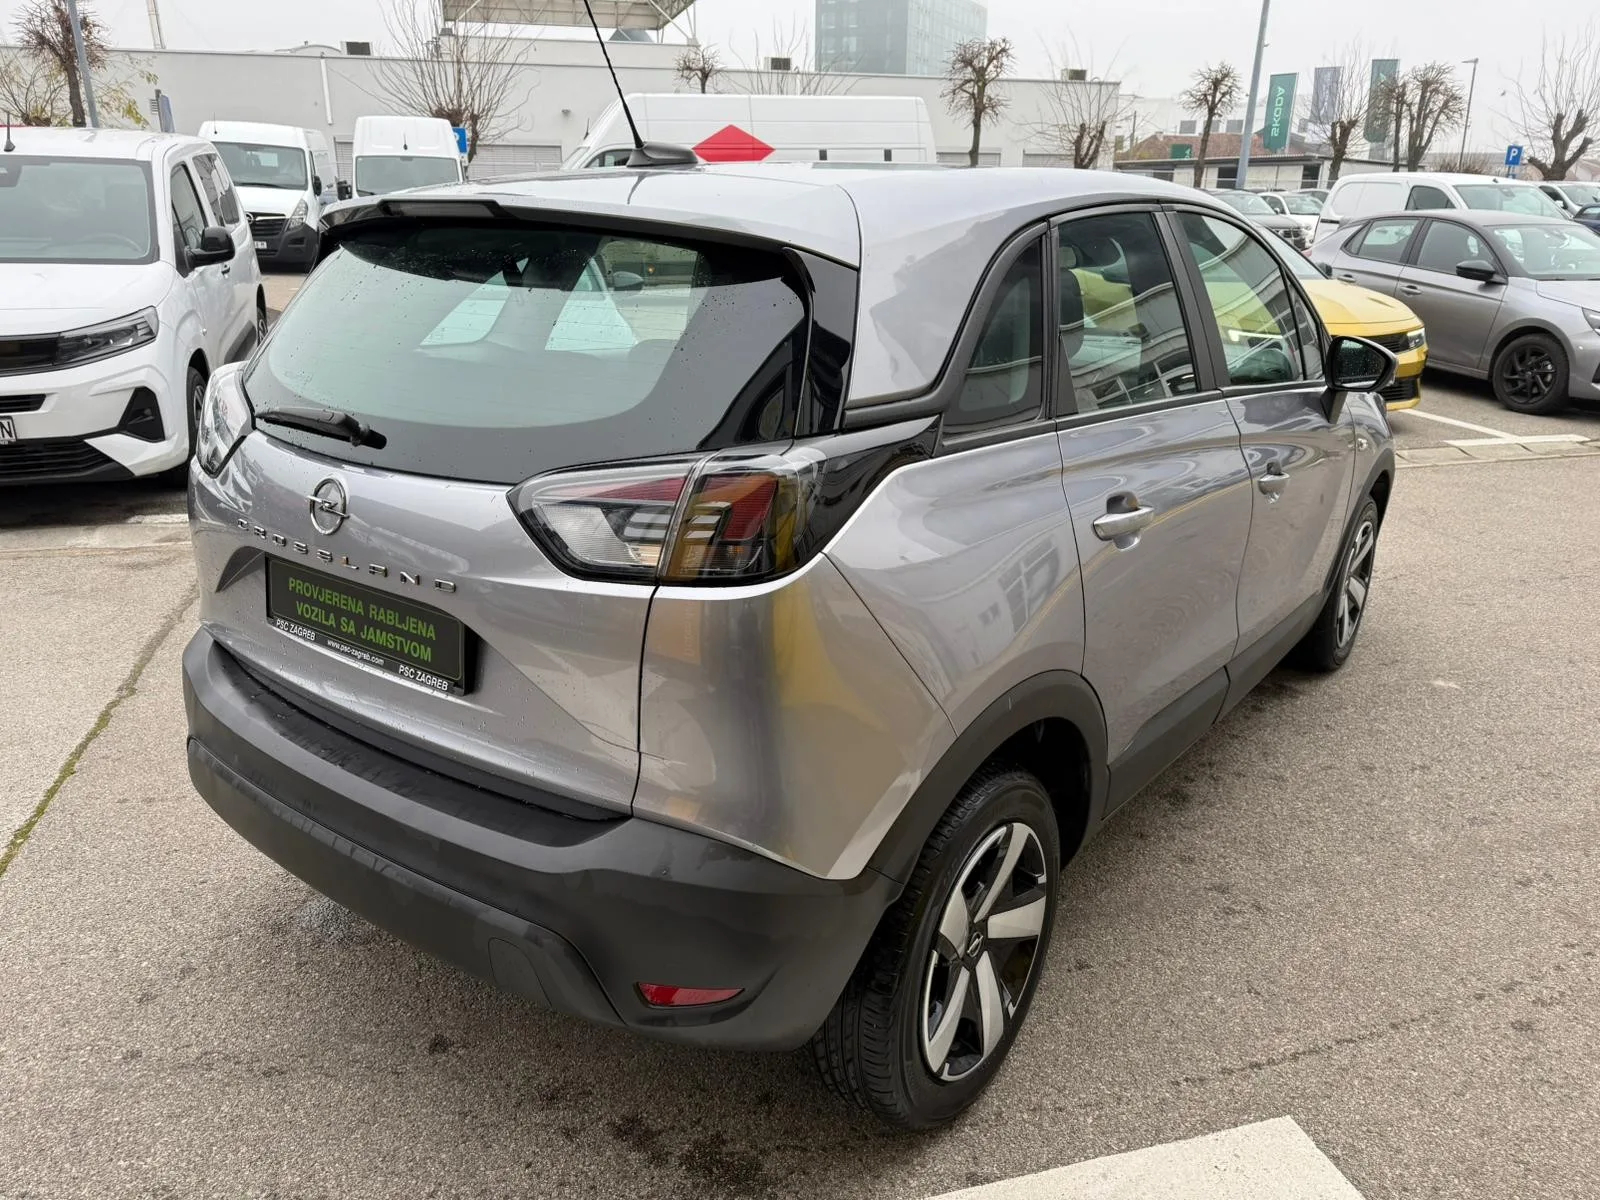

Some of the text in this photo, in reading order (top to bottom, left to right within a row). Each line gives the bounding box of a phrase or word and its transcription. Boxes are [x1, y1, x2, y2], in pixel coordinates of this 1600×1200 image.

[1509, 148, 1519, 161] P
[237, 518, 456, 593] CROSSLAND
[289, 577, 436, 641] PROVJERENA RABLJENA
[276, 618, 316, 641] PSC ZAGREB
[296, 601, 431, 662] VOZILA SA JAMSTVOM
[327, 640, 384, 666] www.psc-zagreb.com
[398, 665, 449, 691] PSC ZAGREB
